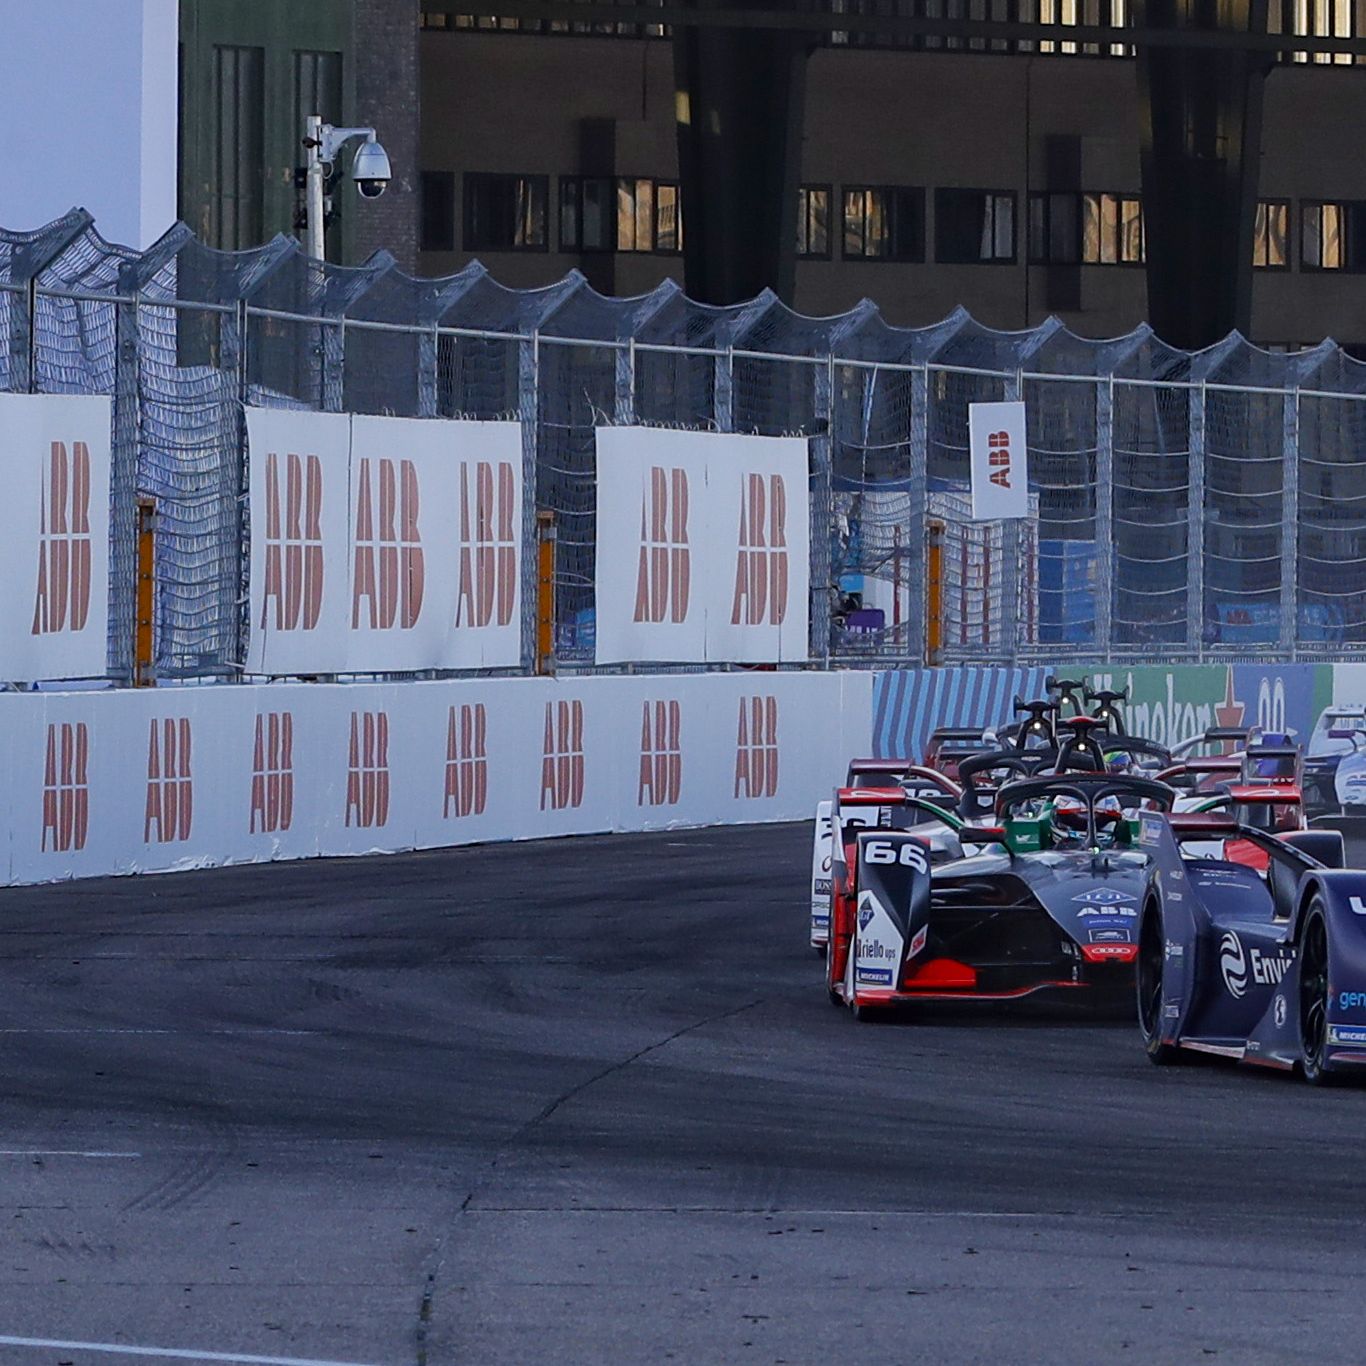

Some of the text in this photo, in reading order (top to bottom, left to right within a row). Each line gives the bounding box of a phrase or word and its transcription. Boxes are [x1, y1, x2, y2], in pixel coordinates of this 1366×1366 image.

[990, 429, 1011, 489] ABB
[262, 452, 324, 631] ABB
[351, 458, 425, 629] ABB
[455, 460, 516, 628] ABB
[634, 466, 691, 624] ABB
[731, 472, 788, 625] ABB
[41, 722, 90, 852] ABB
[144, 717, 192, 843] ABB
[251, 712, 293, 834] ABB
[345, 711, 389, 828] ABB
[443, 703, 487, 819] ABB
[540, 699, 585, 811] ABB
[638, 699, 682, 806] ABB
[734, 695, 779, 800] ABB
[864, 840, 929, 875] 66
[1076, 906, 1138, 918] ABB
